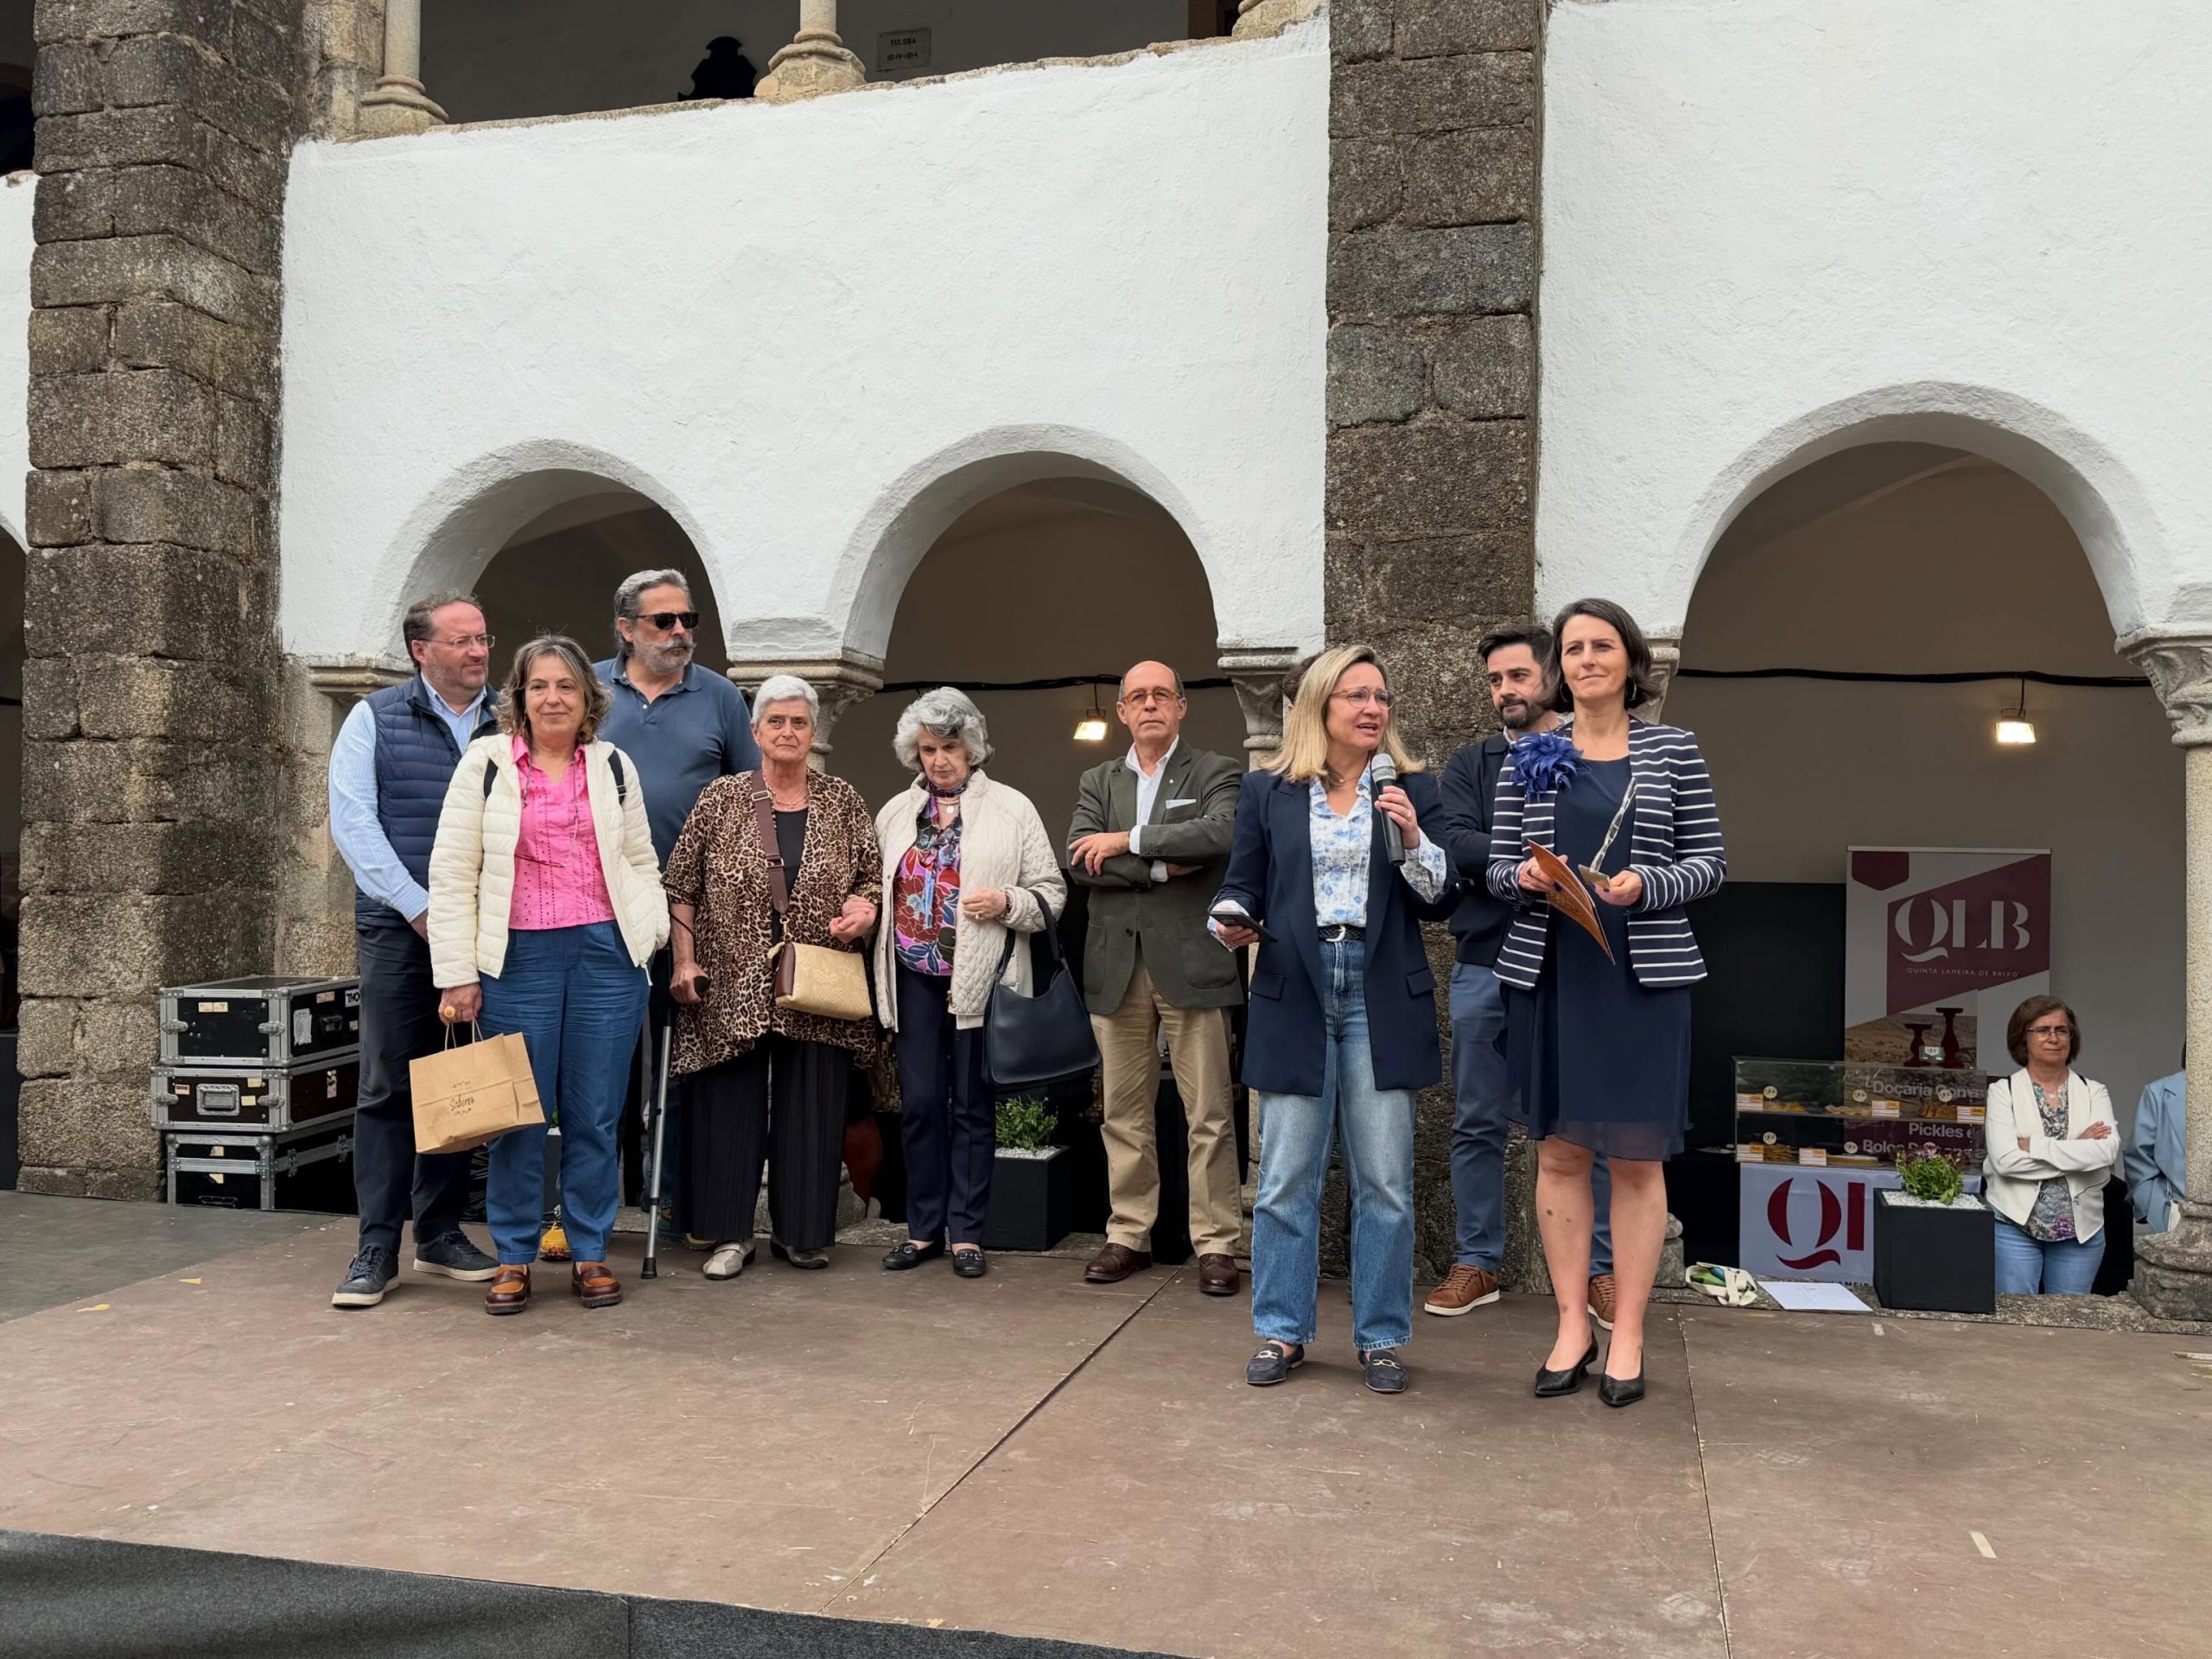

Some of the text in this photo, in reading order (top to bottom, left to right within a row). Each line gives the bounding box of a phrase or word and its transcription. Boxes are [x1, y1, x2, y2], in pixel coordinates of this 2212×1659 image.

[1895, 898, 2031, 963] QLB
[1872, 1080, 1933, 1098] Doçaria
[1909, 1122, 1964, 1138] Pickles
